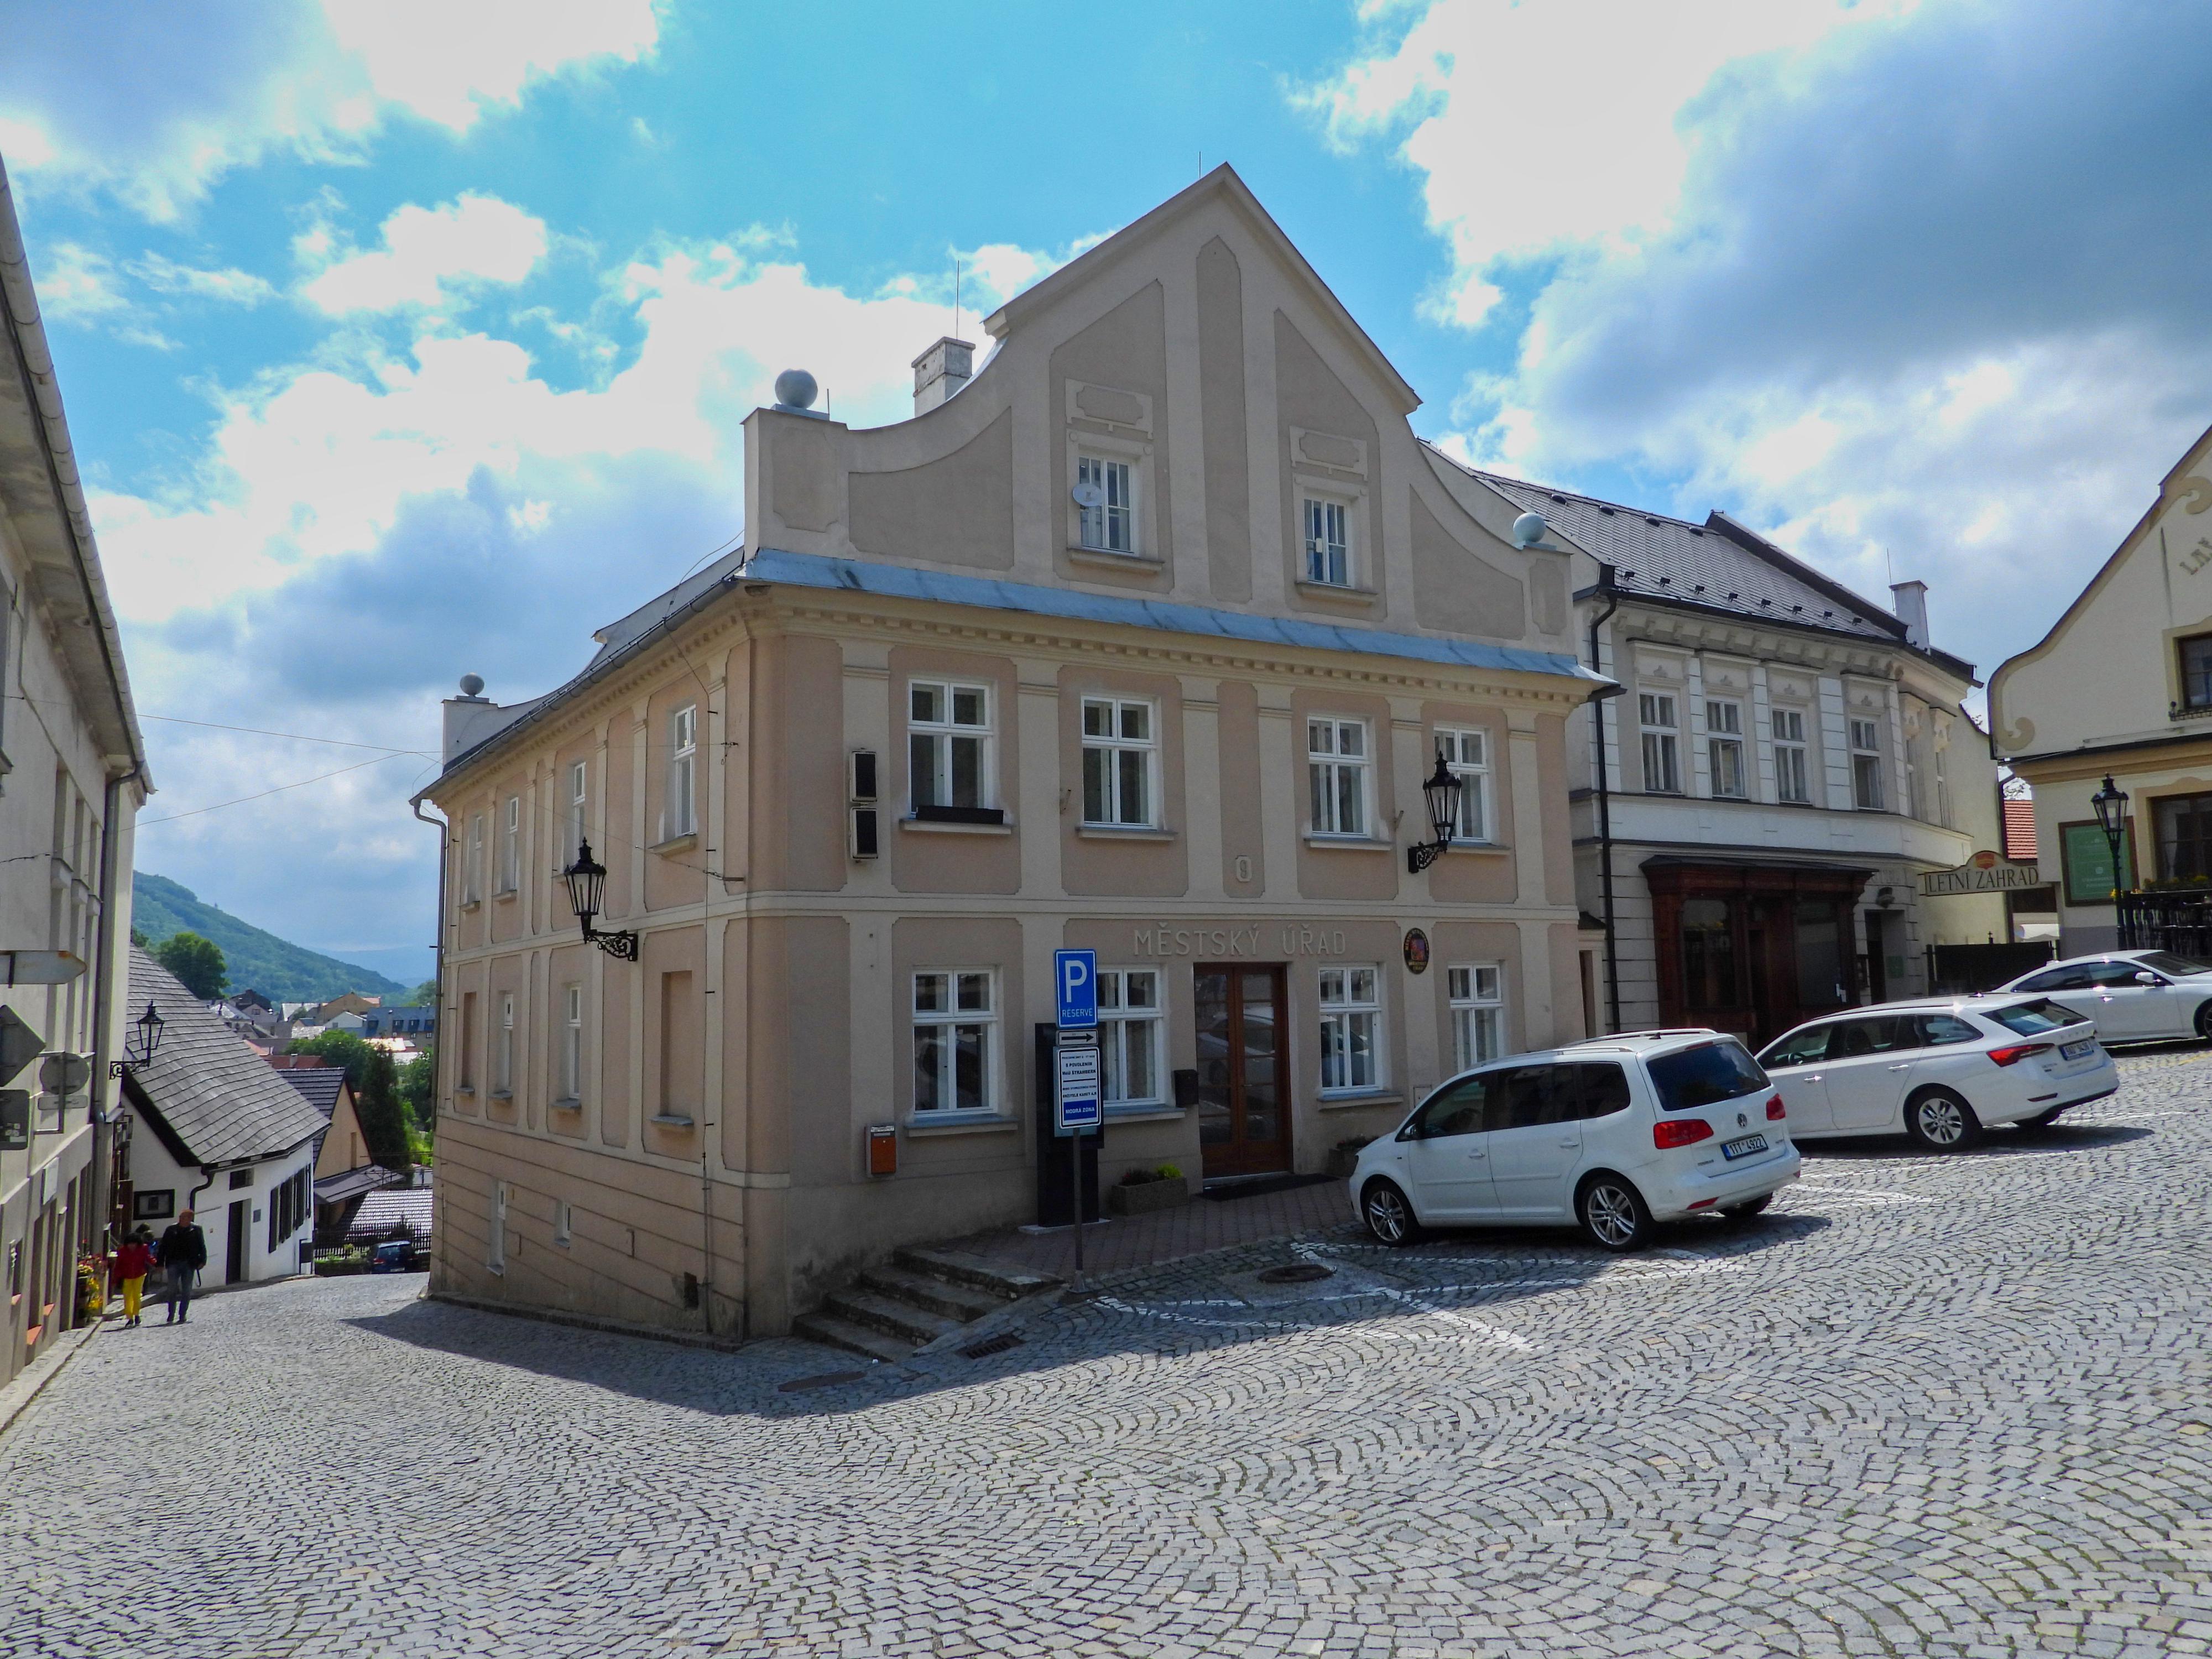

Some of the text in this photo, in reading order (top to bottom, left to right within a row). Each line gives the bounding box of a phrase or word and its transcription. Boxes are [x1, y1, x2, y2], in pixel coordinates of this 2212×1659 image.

[1928, 869, 1970, 893] LETNÍ
[1134, 922, 1346, 956] MĚSTSKÝ ÚŘAD
[1065, 960, 1087, 1003] P
[1729, 1138, 1764, 1154] 1TT 4922
